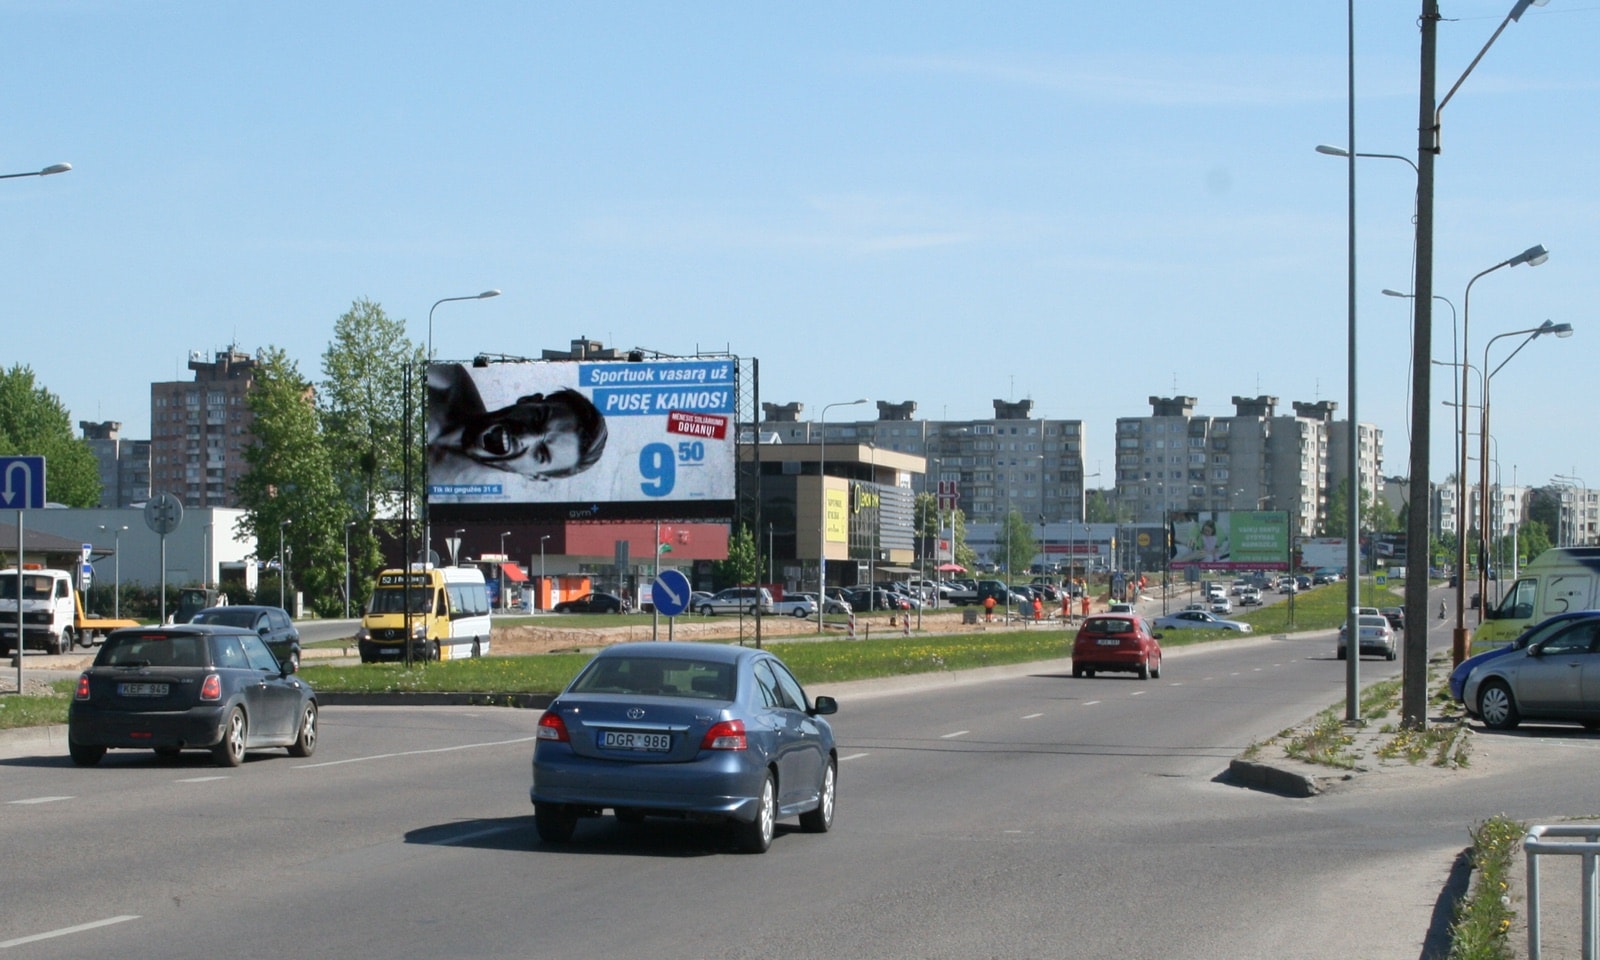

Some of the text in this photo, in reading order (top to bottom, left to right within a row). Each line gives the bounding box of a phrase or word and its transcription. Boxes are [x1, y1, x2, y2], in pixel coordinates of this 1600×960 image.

[591, 365, 729, 384] Sportuok vasarą už
[607, 391, 728, 413] PUSĘ KAINOS!
[678, 421, 715, 438] DOVANŲ!
[639, 441, 704, 497] 9 50
[454, 486, 482, 494] gegužės
[382, 576, 391, 584] 52
[123, 683, 168, 694] KEF 945
[606, 733, 668, 748] DGR 986
